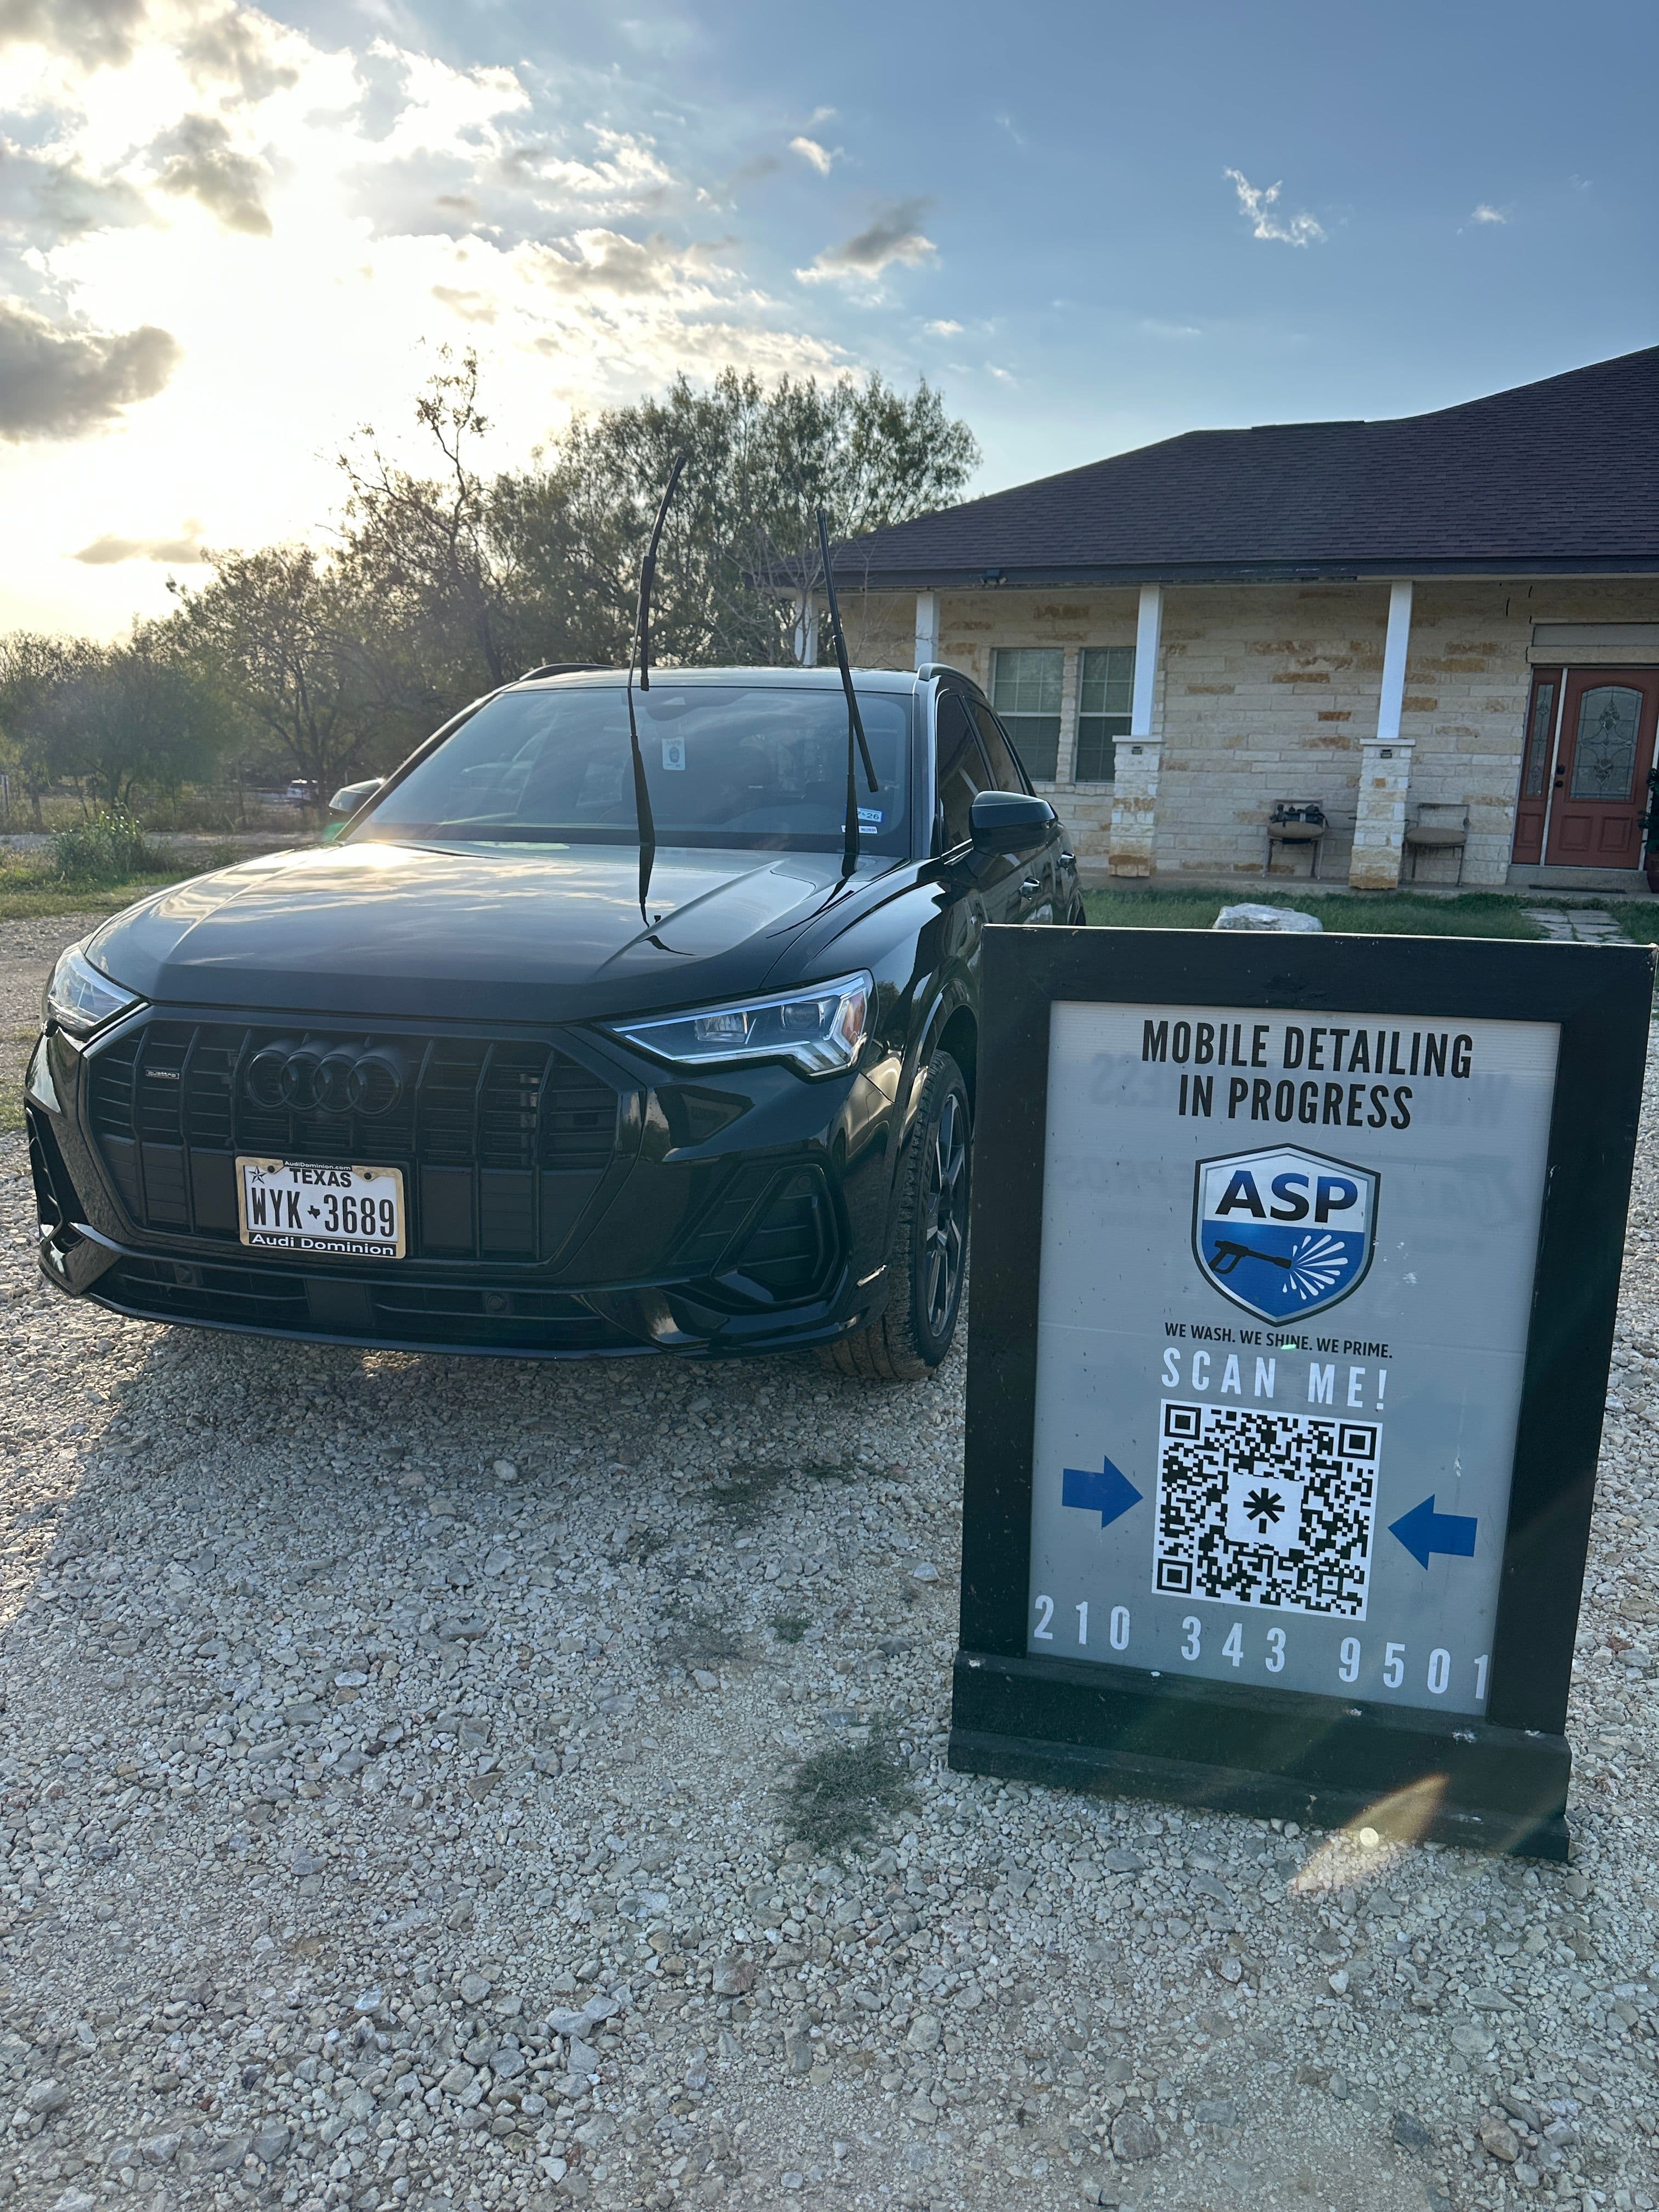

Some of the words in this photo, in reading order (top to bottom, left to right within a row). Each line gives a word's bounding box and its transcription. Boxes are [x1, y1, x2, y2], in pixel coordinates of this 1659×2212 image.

[1142, 1019, 1269, 1068] MOBILE
[1283, 1025, 1472, 1079] DETAILING
[1178, 1074, 1214, 1117] IN
[1228, 1077, 1413, 1130] PROGRESS
[285, 1160, 351, 1171] AudiDominion.com
[289, 1167, 352, 1188] TEXAS
[251, 1187, 303, 1229] WYK
[323, 1194, 395, 1237] 3689
[1215, 1170, 1358, 1223] ASP
[251, 1233, 294, 1248] Audi
[301, 1238, 394, 1256] Dominion
[1165, 1322, 1187, 1338] WE
[1190, 1324, 1235, 1343] WASH.
[1239, 1329, 1262, 1346] WE
[1266, 1332, 1313, 1351] SHINE.
[1316, 1337, 1339, 1353] WE
[1343, 1340, 1393, 1358] PRIME.
[1161, 1347, 1276, 1398] SCAN
[1307, 1362, 1387, 1410] ME!
[1034, 1594, 1131, 1650] 210
[1181, 1616, 1286, 1672] 343
[1338, 1637, 1488, 1700] 9501
